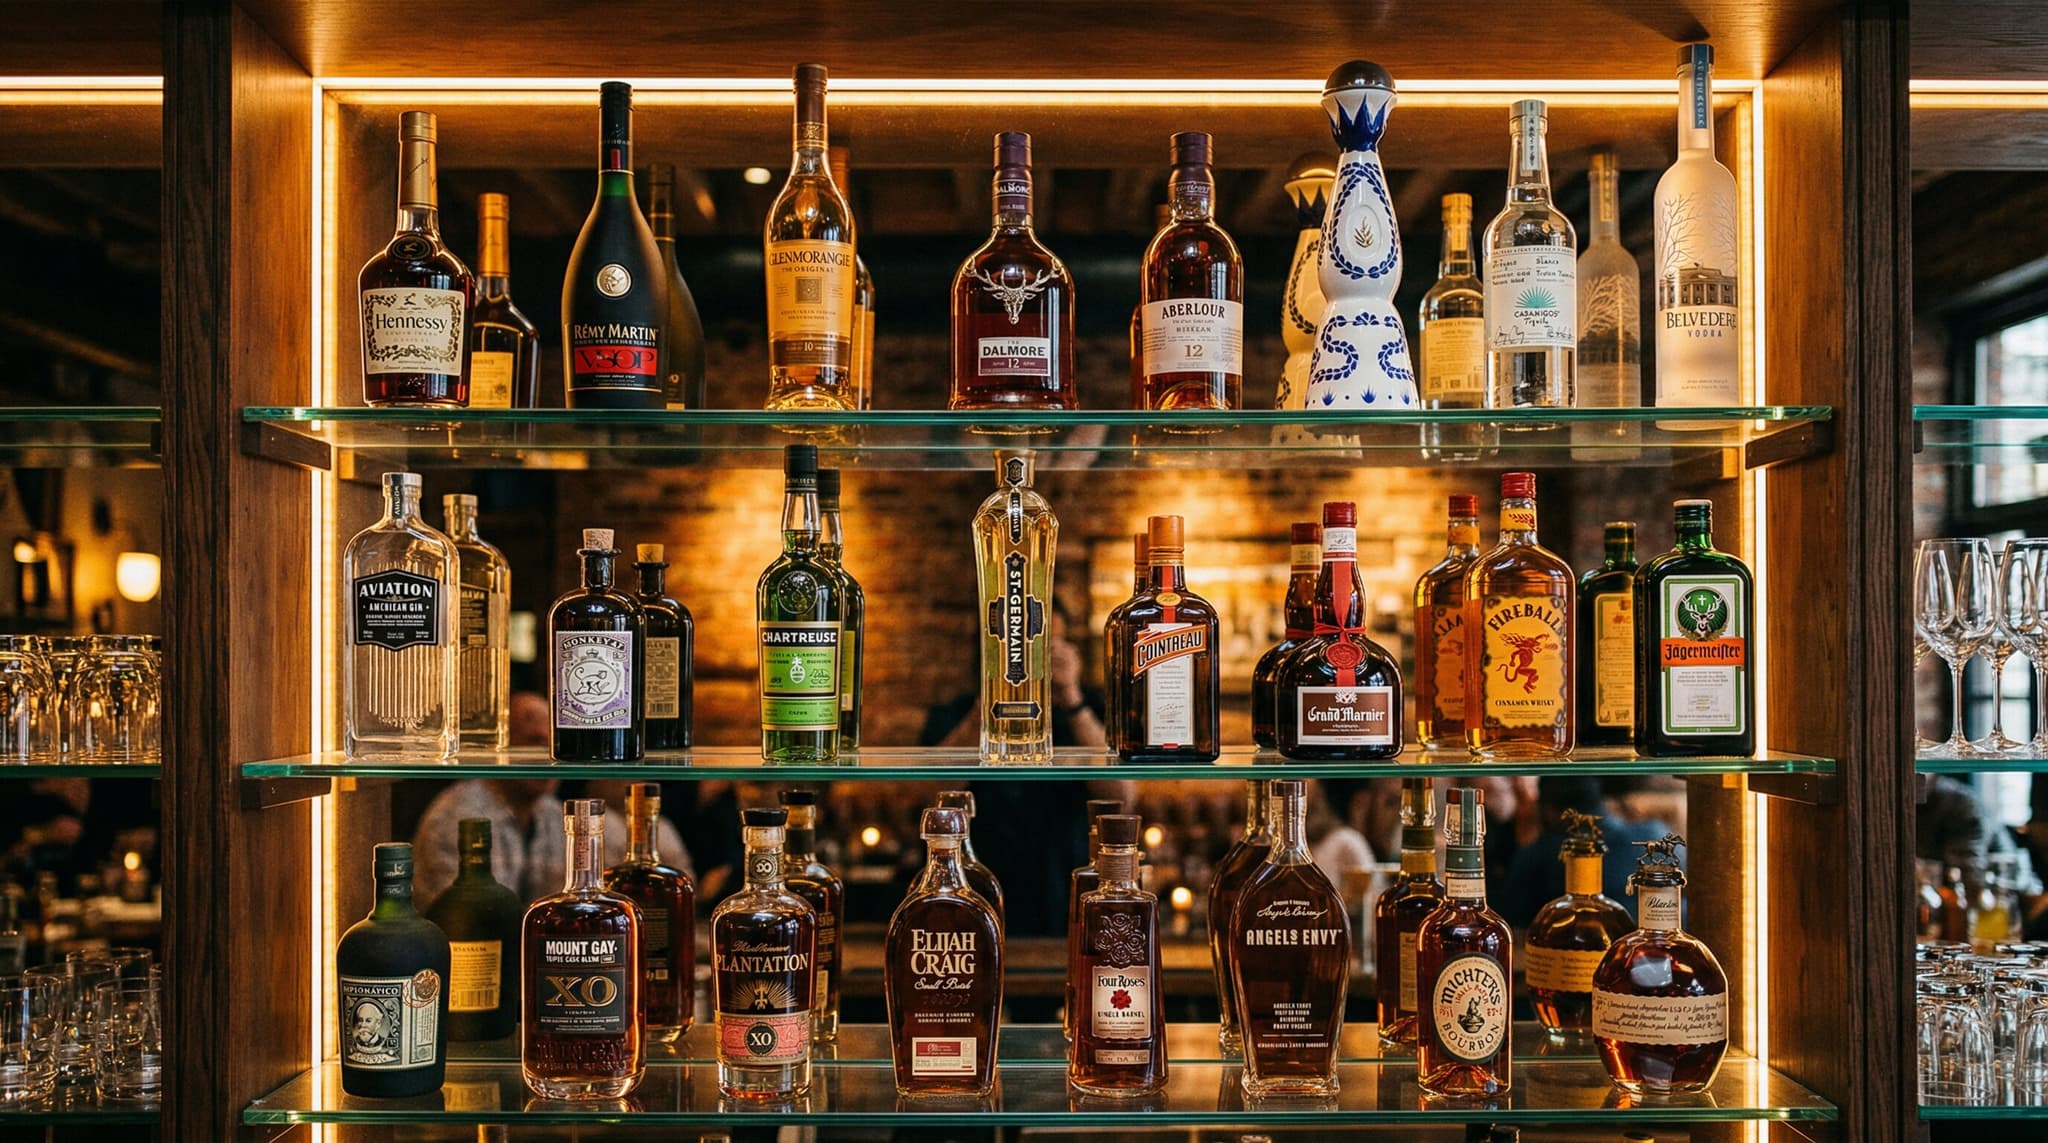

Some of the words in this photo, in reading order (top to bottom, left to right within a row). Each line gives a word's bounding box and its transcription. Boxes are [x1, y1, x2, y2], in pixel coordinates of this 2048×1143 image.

[768, 250, 851, 267] GLENMORANGIE
[1161, 303, 1225, 319] ABERLOUR
[375, 313, 448, 334] Hennessy
[1666, 311, 1737, 329] BELVEDERE
[574, 323, 606, 340] RÉMY
[608, 323, 657, 341] MARTIN
[983, 346, 1046, 356] DALMORE
[1184, 344, 1203, 357] 12
[1007, 358, 1020, 369] 12
[359, 582, 433, 598] AVIATION
[1009, 570, 1022, 663] ST-GERMAIN
[563, 636, 611, 649] MONKEY
[761, 632, 837, 643] CHARTREUSE
[1137, 631, 1202, 668] COINTREAU
[1307, 706, 1340, 722] Grand
[1340, 706, 1385, 722] Marnier
[911, 929, 977, 955] ELIJAH
[1302, 928, 1337, 945] ENVY
[545, 941, 588, 955] MOUNT
[591, 940, 616, 955] GAY
[911, 951, 977, 977] CRAIG
[914, 978, 943, 990] Small
[1097, 975, 1118, 987] Four
[1118, 975, 1145, 988] Roses
[1441, 967, 1501, 1006] MICHTER'S
[544, 975, 618, 1007] XO
[750, 1032, 772, 1046] XO
[1442, 1022, 1500, 1051] BOURBON
